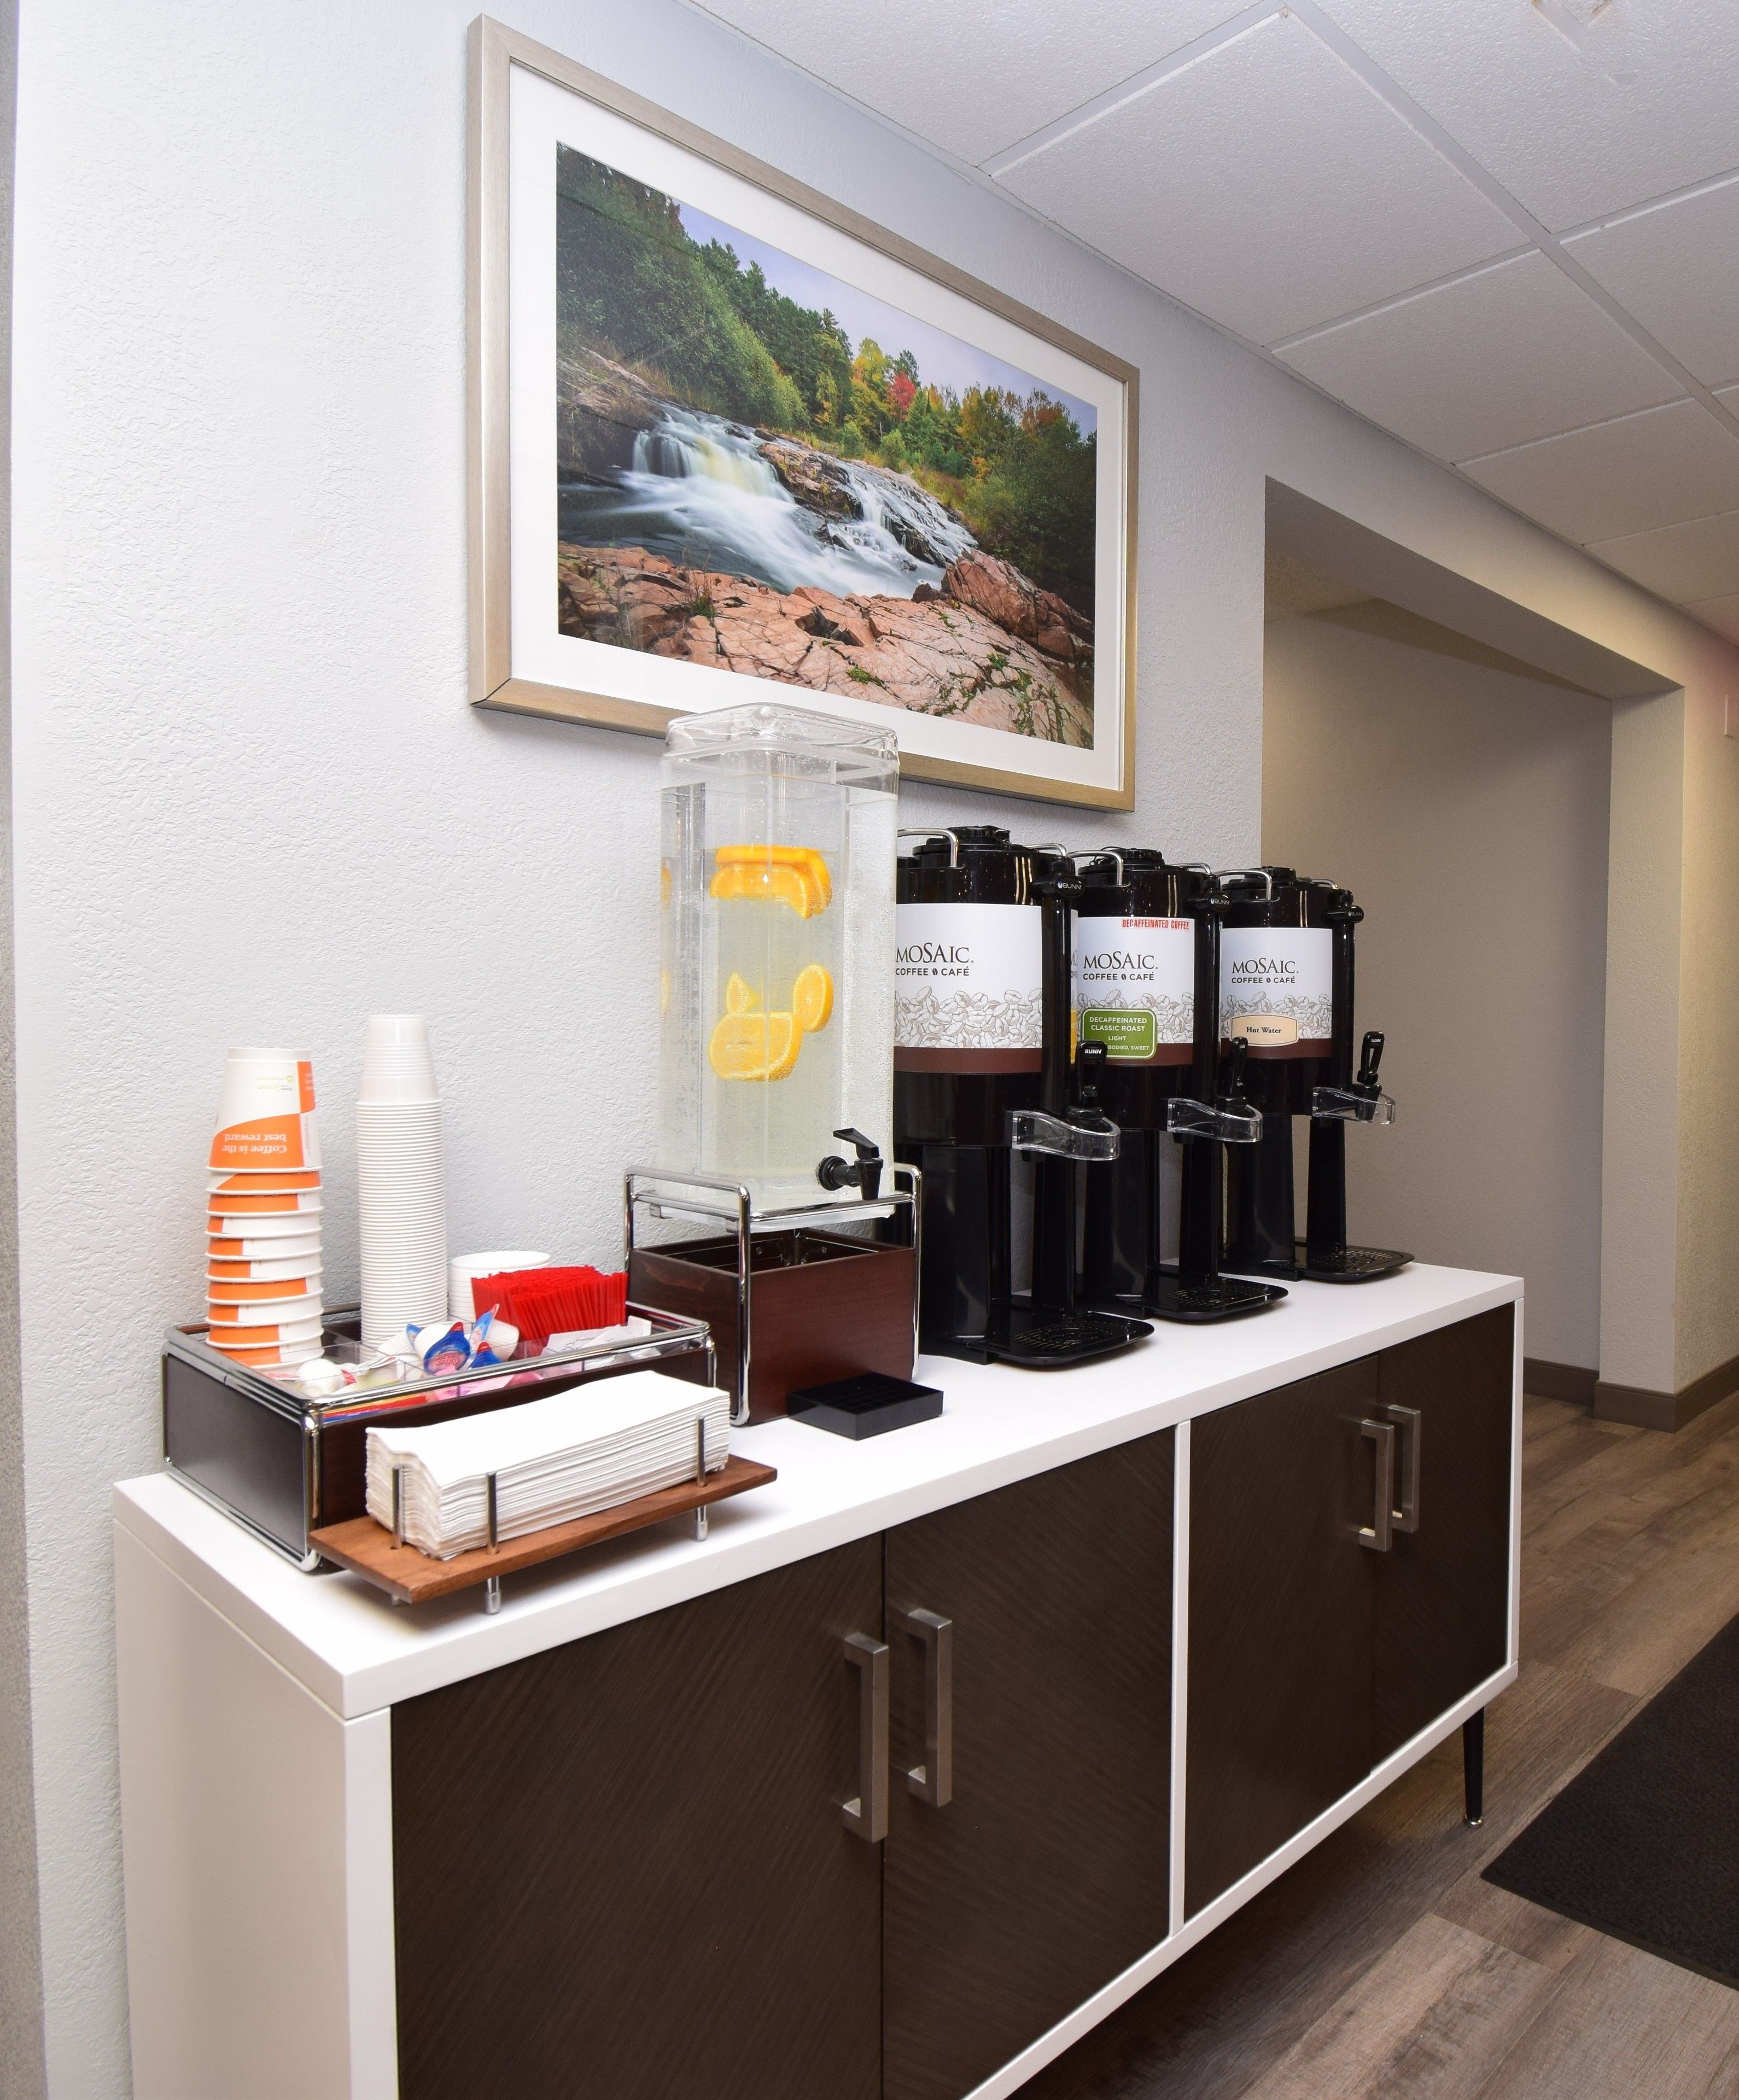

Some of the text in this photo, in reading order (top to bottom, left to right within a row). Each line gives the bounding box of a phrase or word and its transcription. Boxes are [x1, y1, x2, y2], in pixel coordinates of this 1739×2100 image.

[1122, 919, 1189, 930] DECAFFEINATED COFFEE
[896, 942, 970, 964] MOSAIC
[1083, 951, 1154, 970] MOSAIC
[895, 966, 970, 976] COFFEE CAFÉ
[1232, 958, 1296, 974] MOSAIC
[1129, 972, 1154, 981] CAFÉ
[263, 1134, 287, 1142] best
[223, 1145, 287, 1154] Coffee is the
